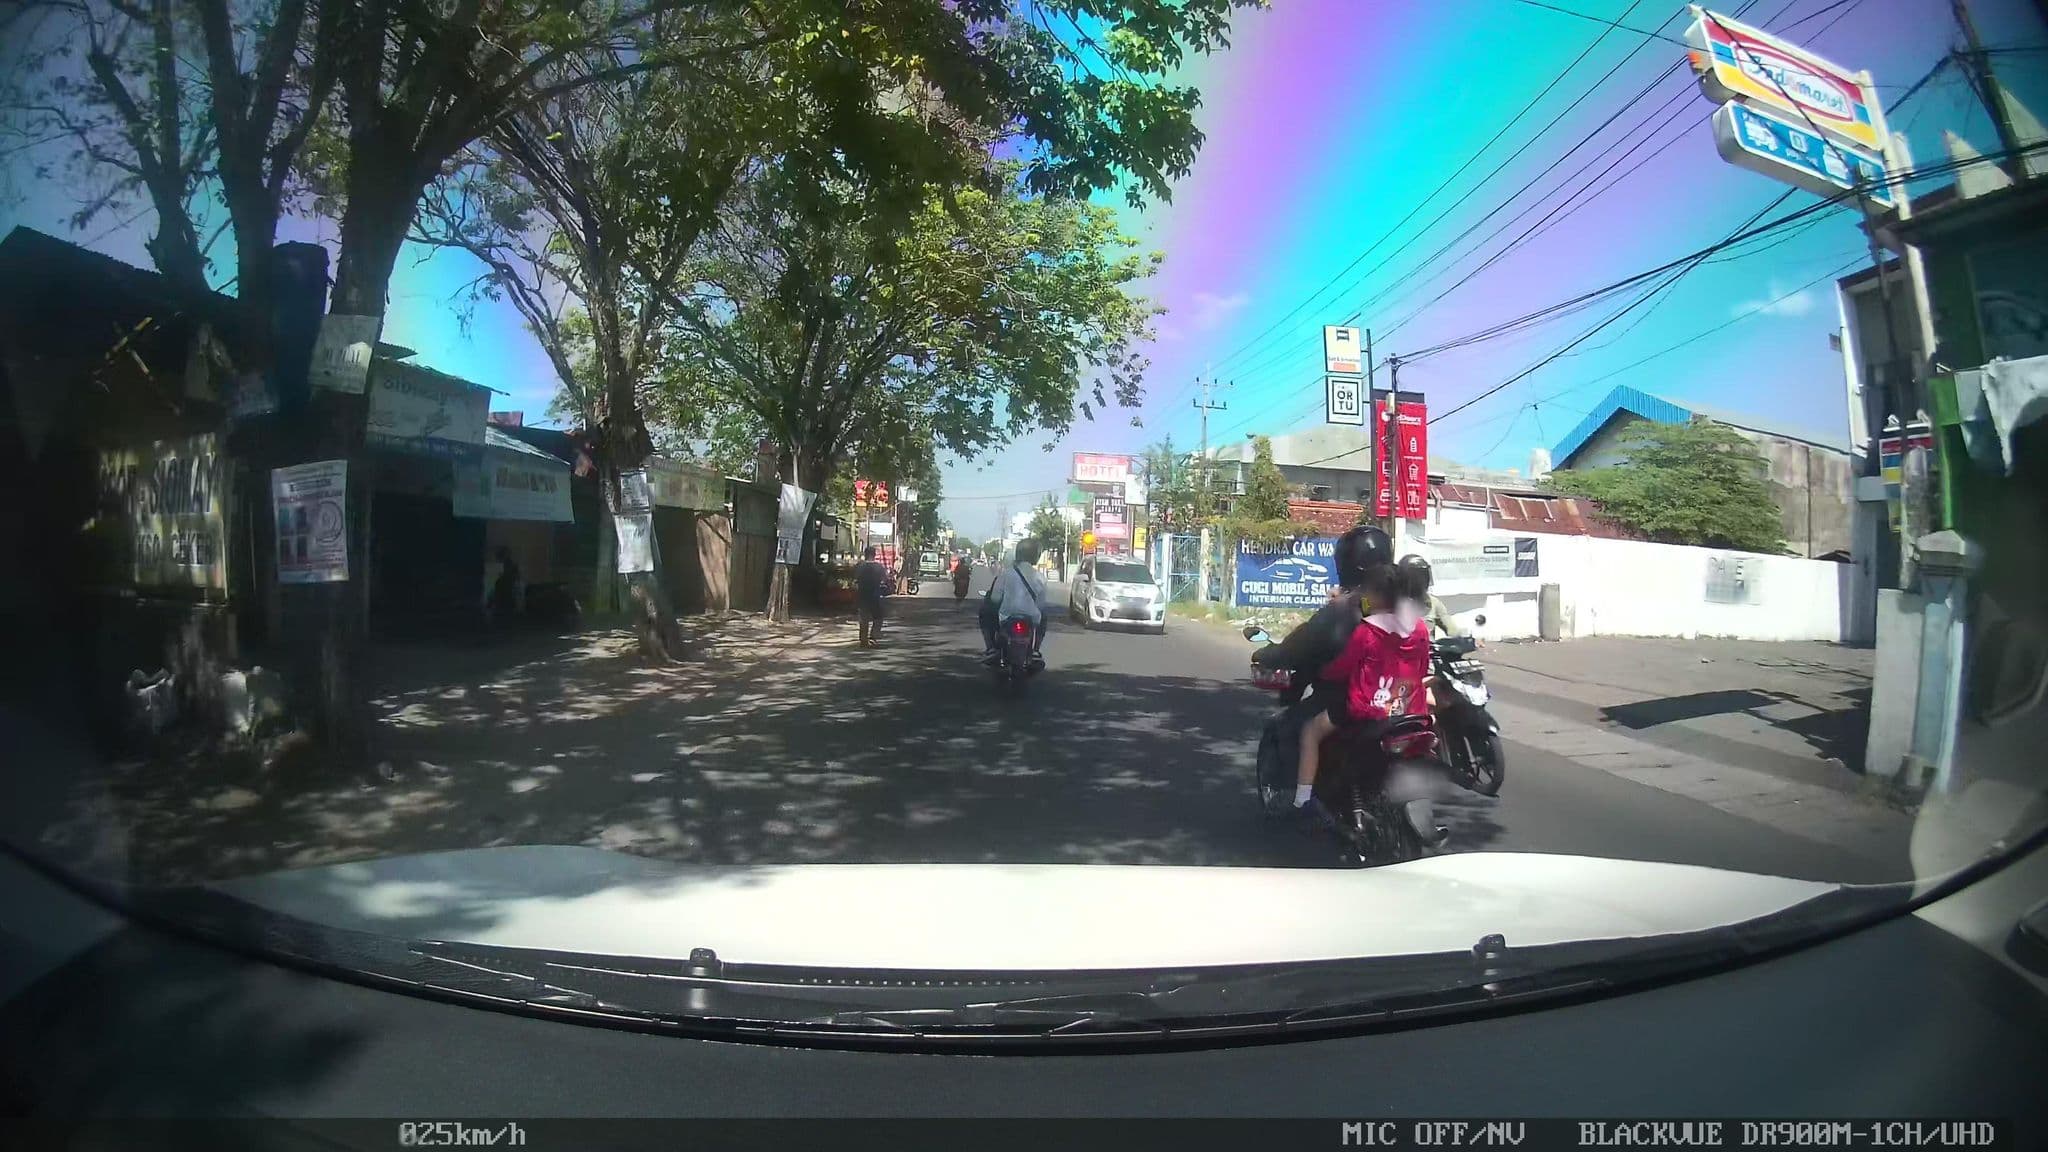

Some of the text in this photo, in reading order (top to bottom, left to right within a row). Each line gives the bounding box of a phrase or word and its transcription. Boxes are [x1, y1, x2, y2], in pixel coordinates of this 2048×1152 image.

[1337, 390, 1354, 401] OR
[1338, 401, 1354, 411] TU
[1292, 541, 1315, 557] CAR
[1318, 542, 1336, 557] WA
[1271, 582, 1309, 595] MOBIL
[1248, 595, 1327, 605] INTERIOR CLEANI
